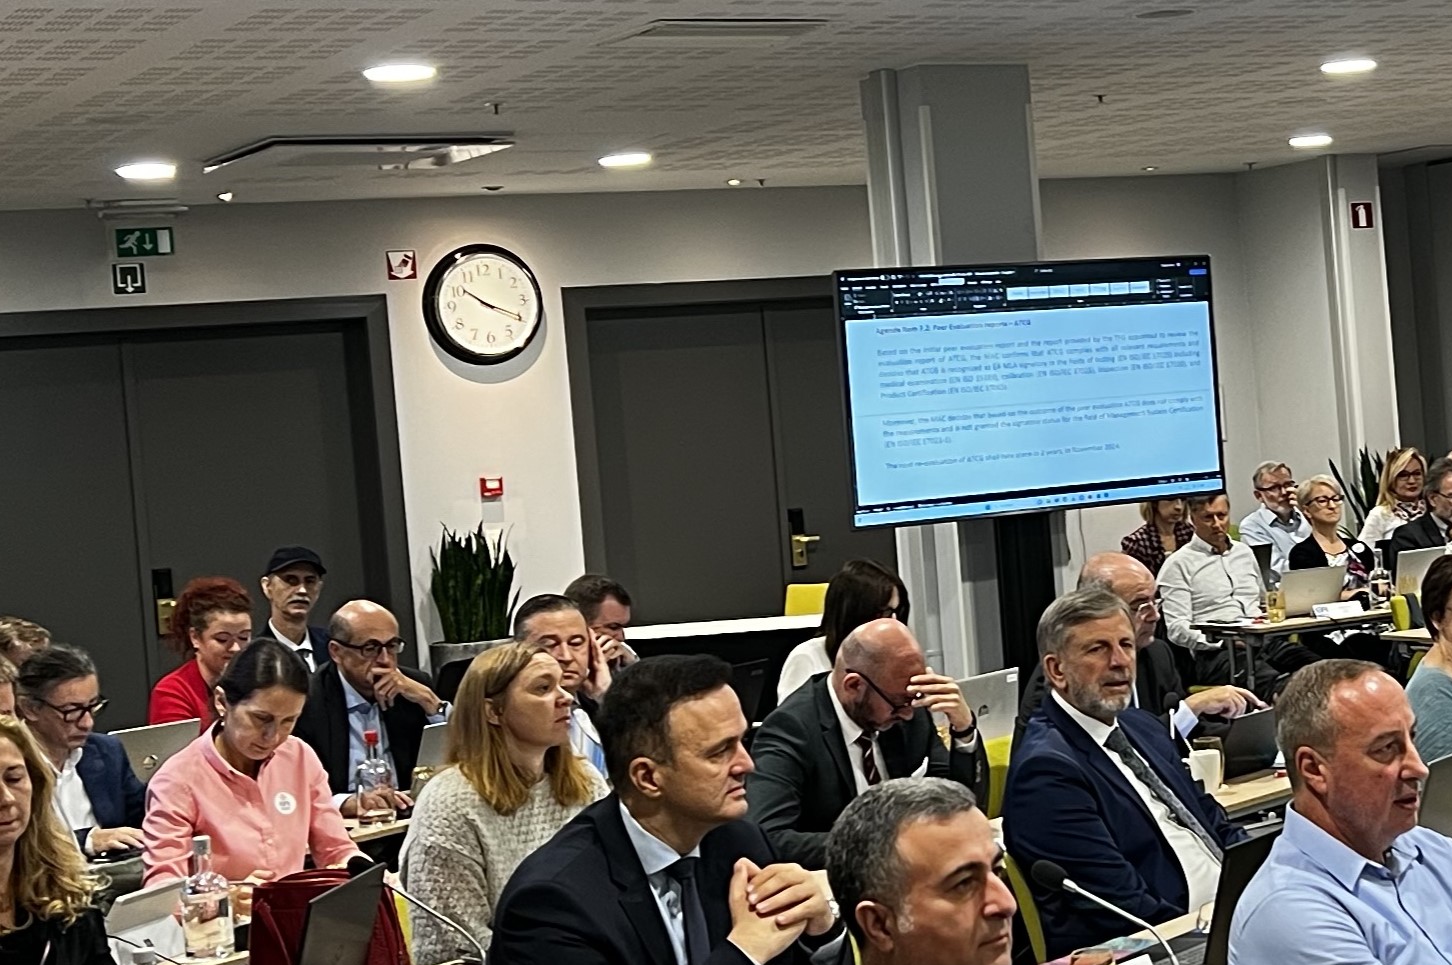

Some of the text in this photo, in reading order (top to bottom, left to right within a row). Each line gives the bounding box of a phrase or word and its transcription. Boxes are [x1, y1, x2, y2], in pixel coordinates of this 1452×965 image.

[476, 264, 490, 276] 12
[498, 267, 503, 279] 1
[462, 271, 474, 282] 11
[510, 277, 519, 288] 2
[452, 285, 466, 298] 10
[520, 294, 527, 306] 3
[447, 301, 457, 312] 9
[455, 318, 464, 330] 8
[470, 328, 479, 340] 7
[486, 331, 496, 343] 6
[505, 325, 514, 338] 5
